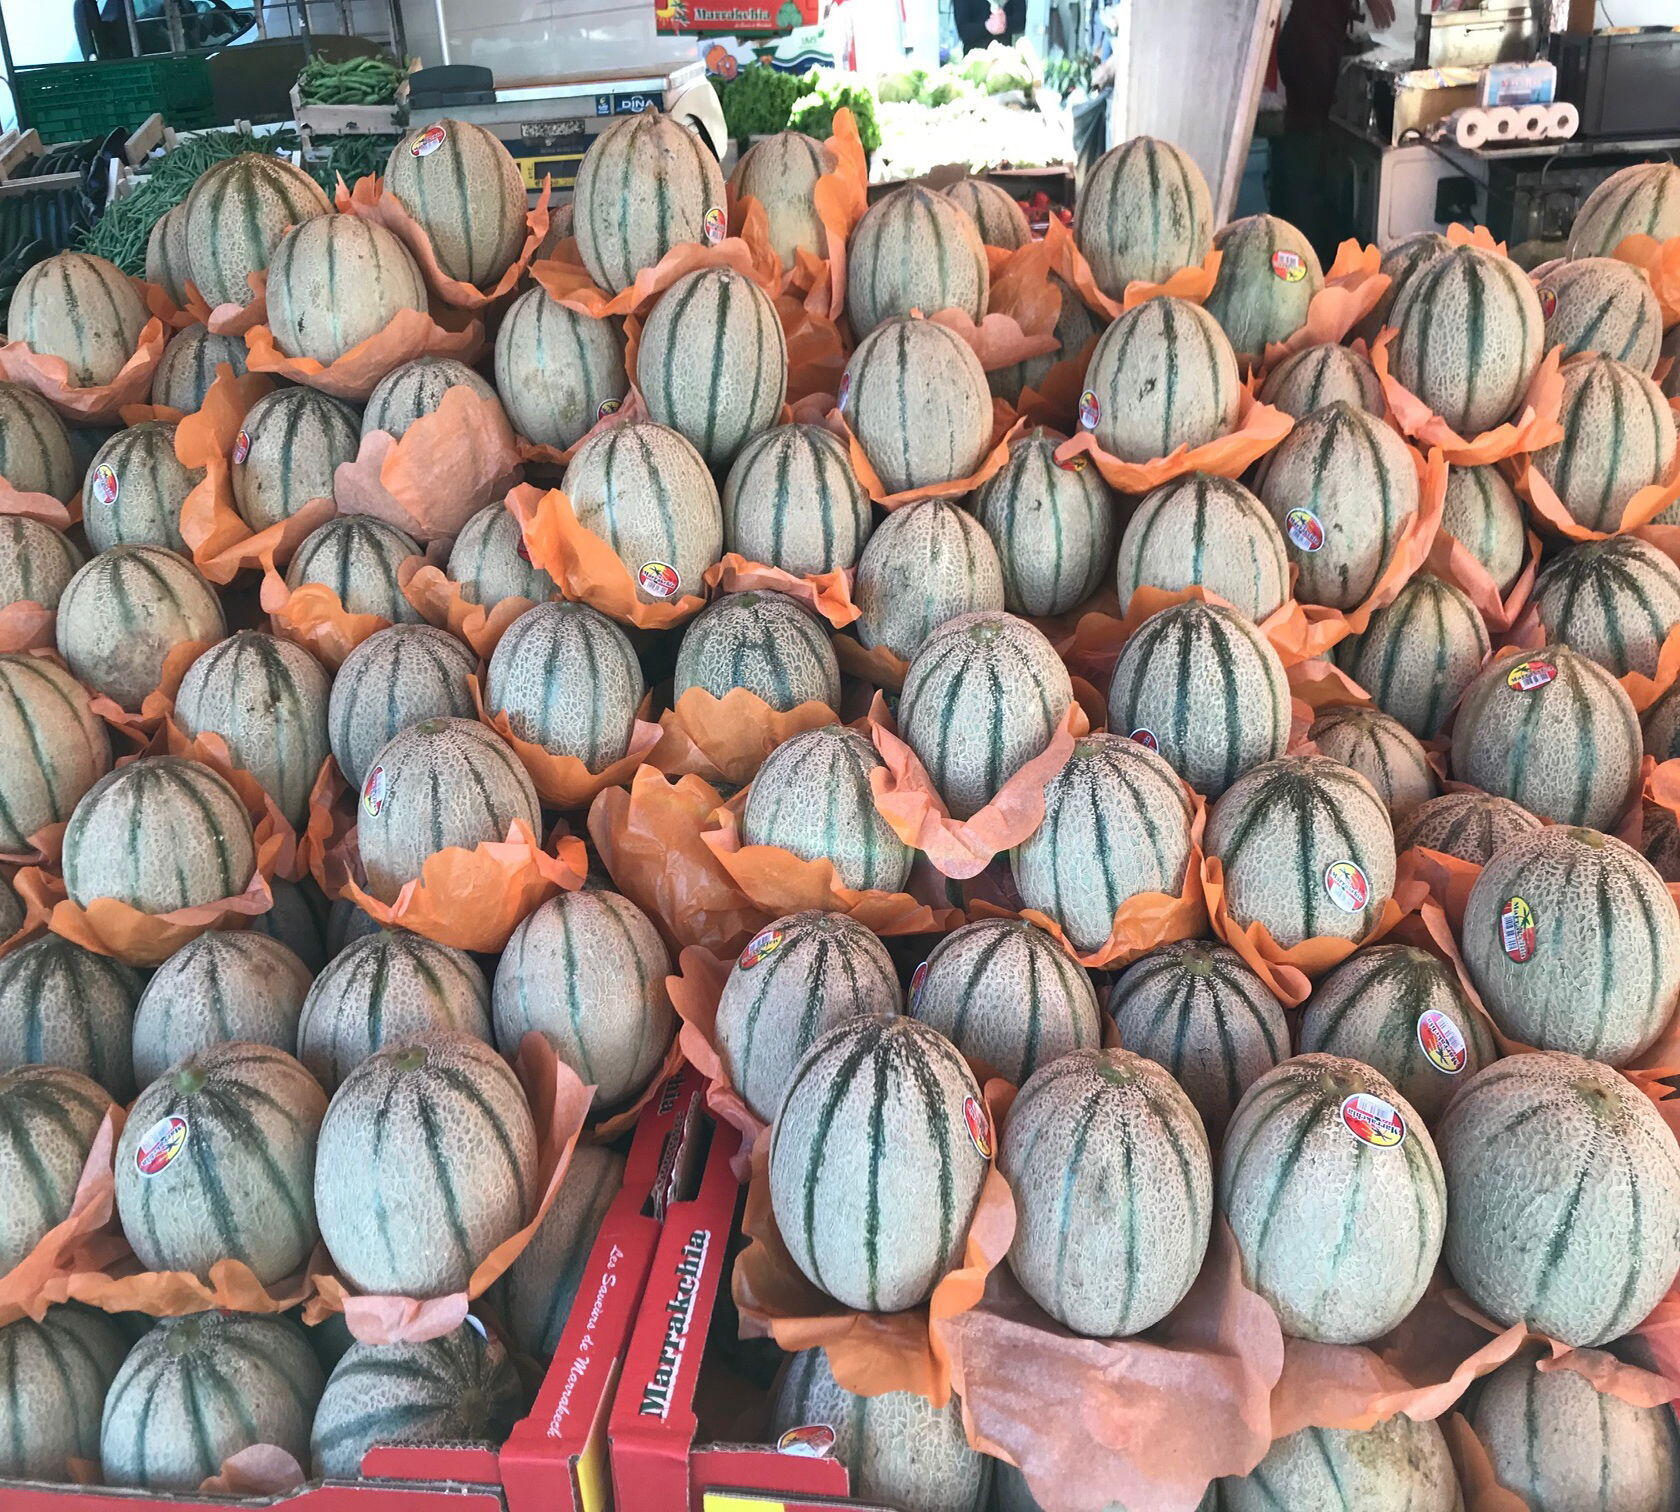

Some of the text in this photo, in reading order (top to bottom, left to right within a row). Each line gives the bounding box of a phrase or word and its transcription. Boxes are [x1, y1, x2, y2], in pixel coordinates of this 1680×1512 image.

[1347, 1108, 1399, 1135] Marrakchia
[546, 1244, 624, 1439] Les Saveurs de Marrakech
[638, 1229, 711, 1420] Marrakchia
